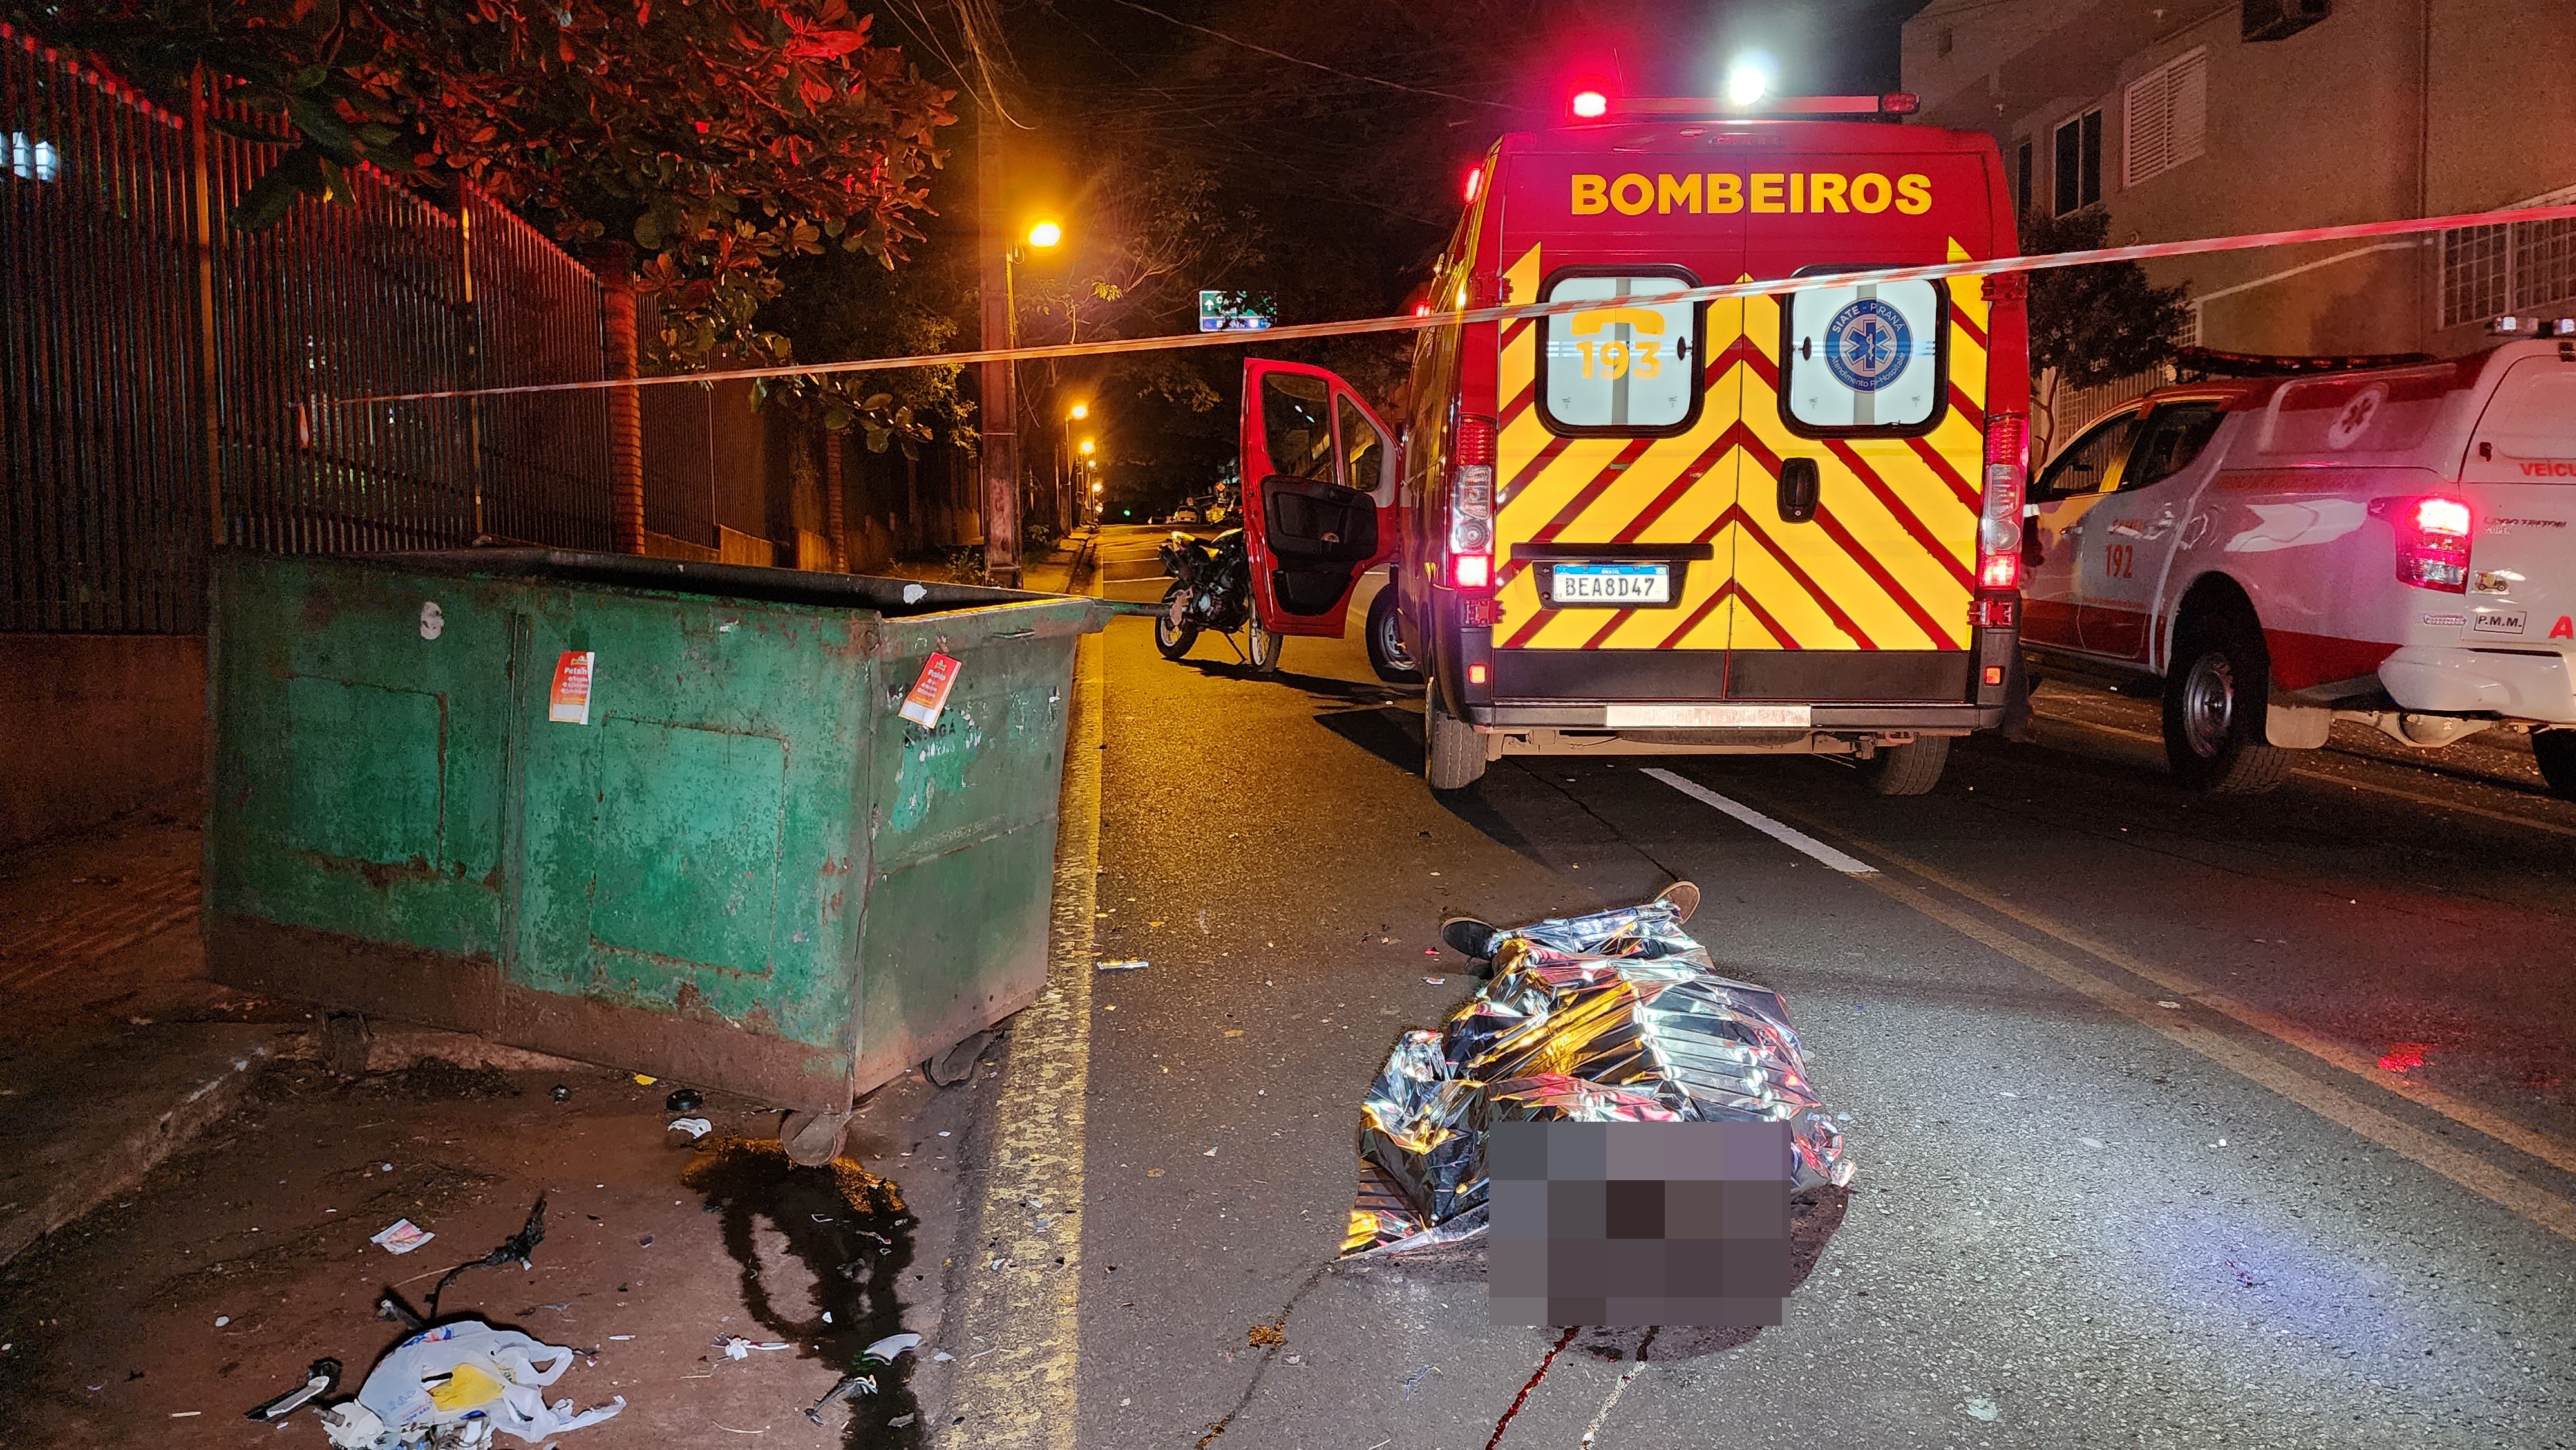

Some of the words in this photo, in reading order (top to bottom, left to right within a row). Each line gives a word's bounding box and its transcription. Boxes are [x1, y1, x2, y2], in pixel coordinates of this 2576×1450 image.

[1571, 173, 1932, 214] BOMBEIROS
[1832, 305, 1861, 333] SIATE
[1870, 303, 1906, 332] PRANÁ
[1576, 340, 1662, 380] 193
[1830, 355, 1868, 388] Atendimento
[2106, 543, 2133, 578] 192
[1566, 578, 1654, 596] BEA8D47
[2478, 615, 2522, 628] P.M.M.
[2548, 615, 2574, 639] A
